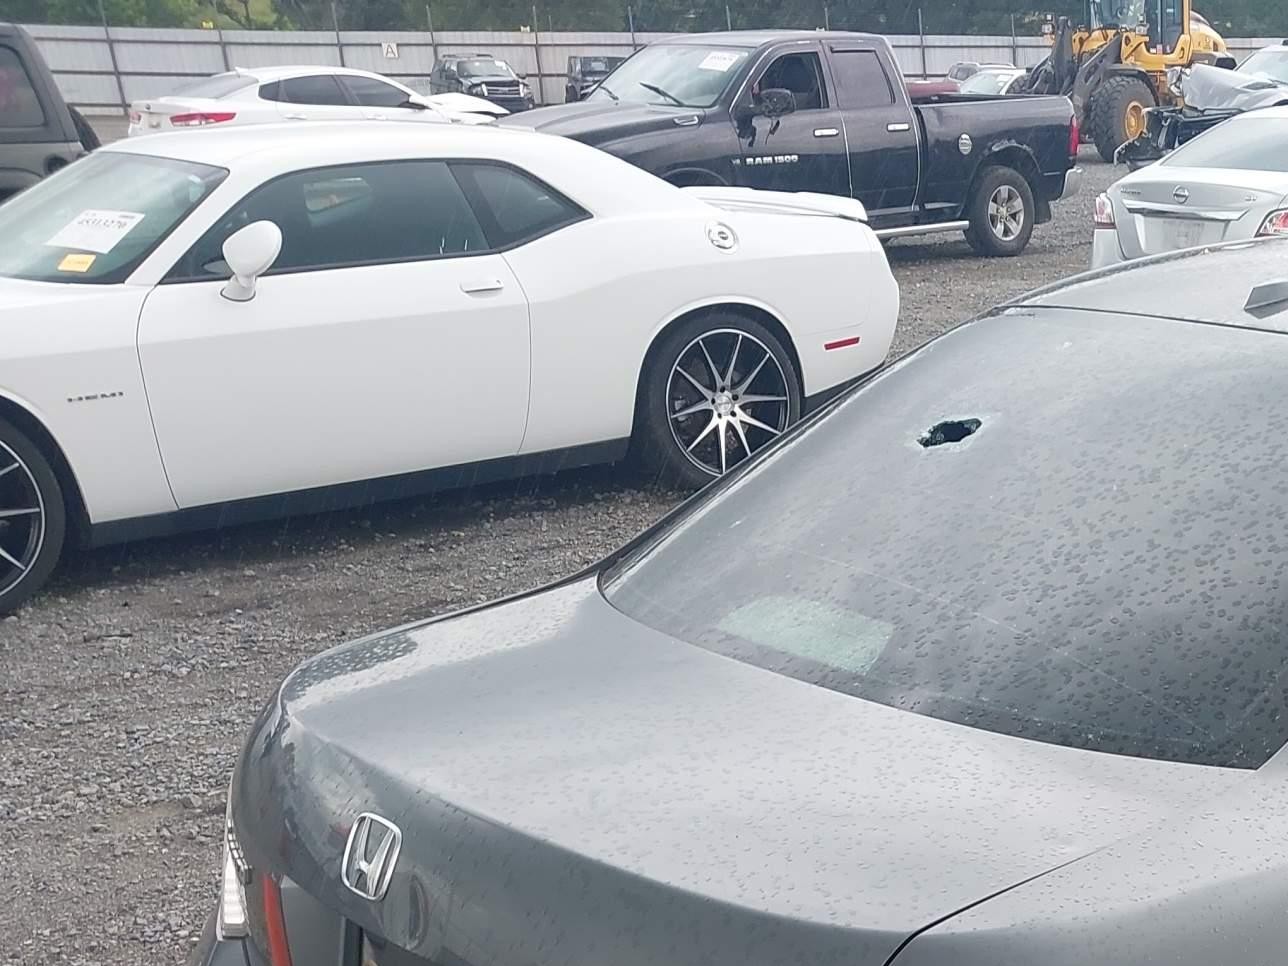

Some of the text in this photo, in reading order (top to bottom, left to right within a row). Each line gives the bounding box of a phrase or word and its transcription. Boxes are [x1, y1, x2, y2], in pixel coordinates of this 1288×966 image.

[385, 44, 396, 57] A
[745, 156, 773, 165] RAM
[774, 154, 798, 164] 1500
[67, 391, 123, 402] HEMI
